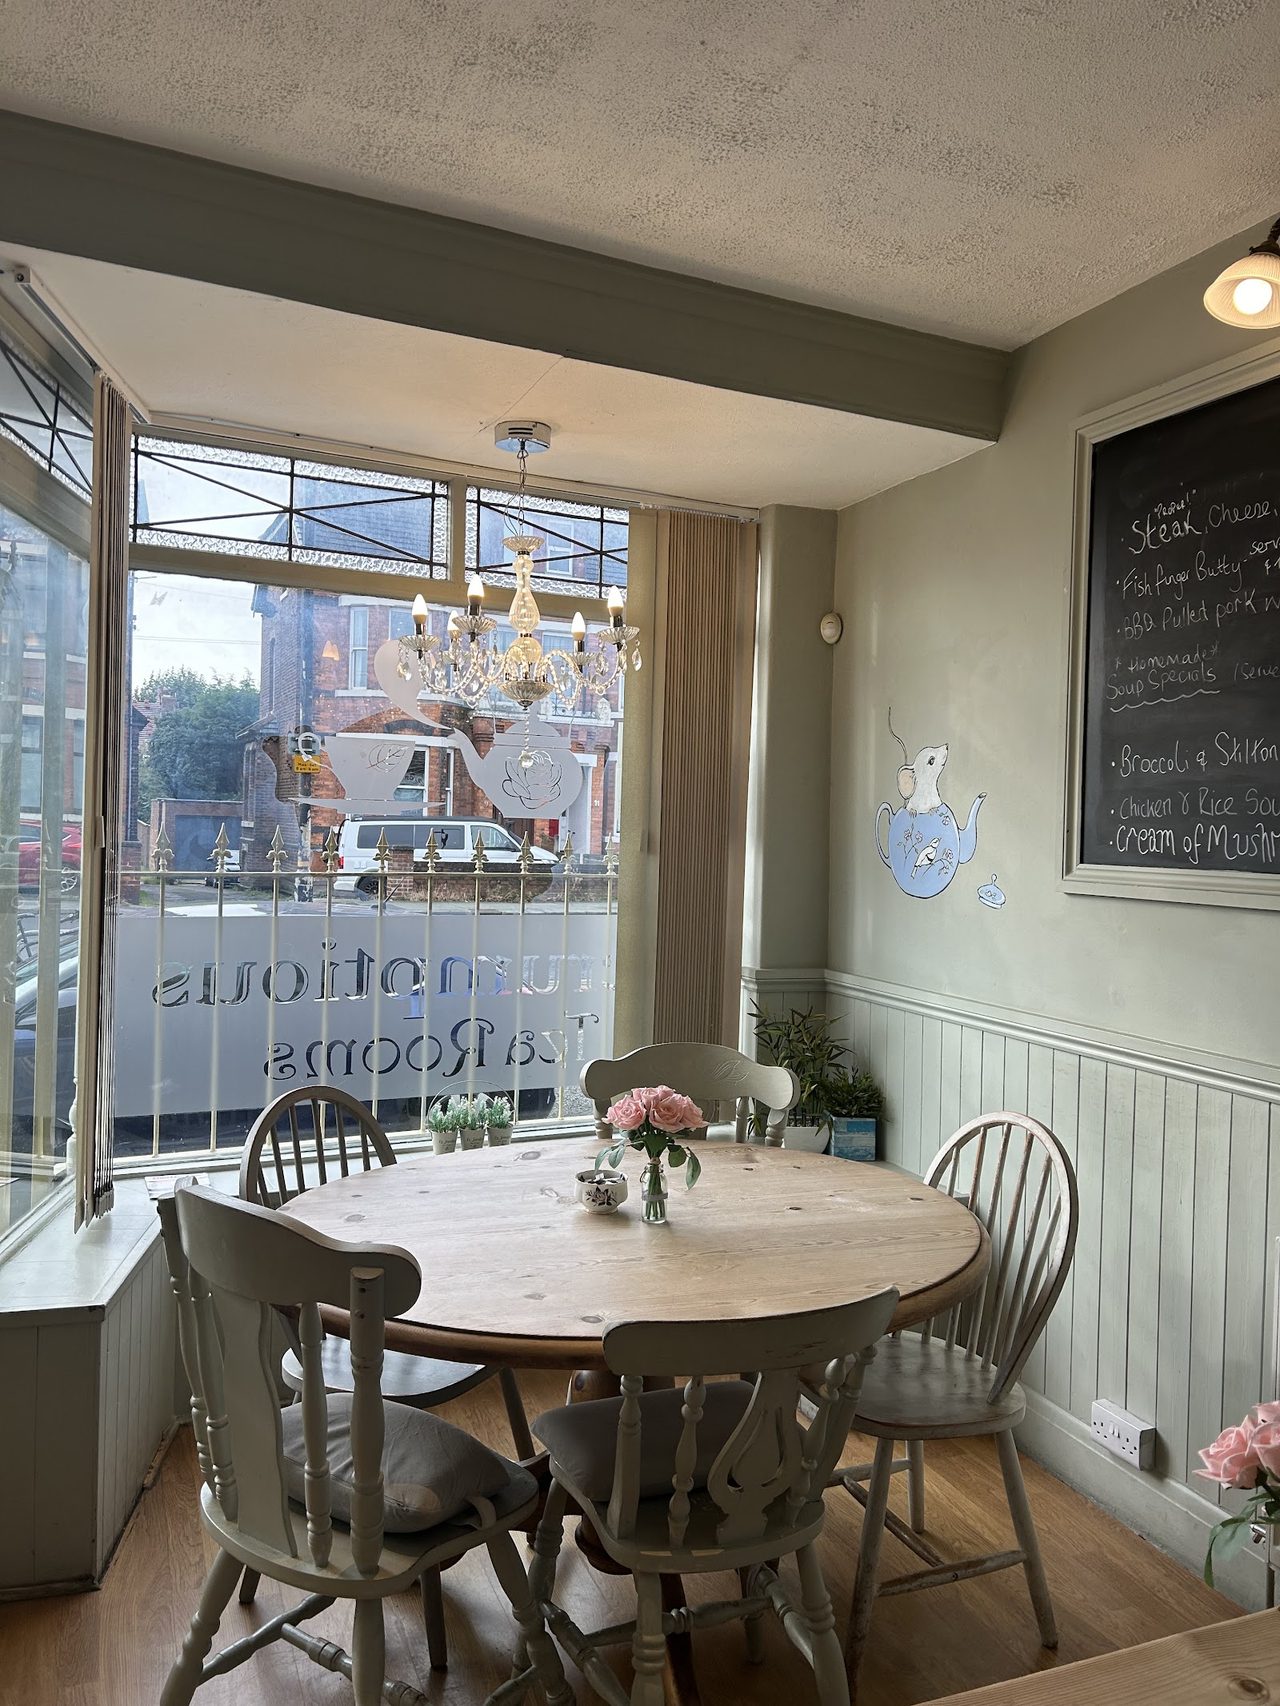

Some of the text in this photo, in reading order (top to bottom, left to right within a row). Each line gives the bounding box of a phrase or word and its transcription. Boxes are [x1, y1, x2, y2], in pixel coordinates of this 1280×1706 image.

[1122, 567, 1153, 600] Fish
[1123, 611, 1156, 640] BBQ
[1106, 673, 1145, 700] Soup
[1147, 661, 1217, 692] Specials
[1119, 739, 1190, 777] Broccoli
[1214, 731, 1279, 766] Stilton
[1119, 796, 1172, 820] Chicken
[1199, 787, 1238, 817] Rice
[1183, 823, 1204, 864] of
